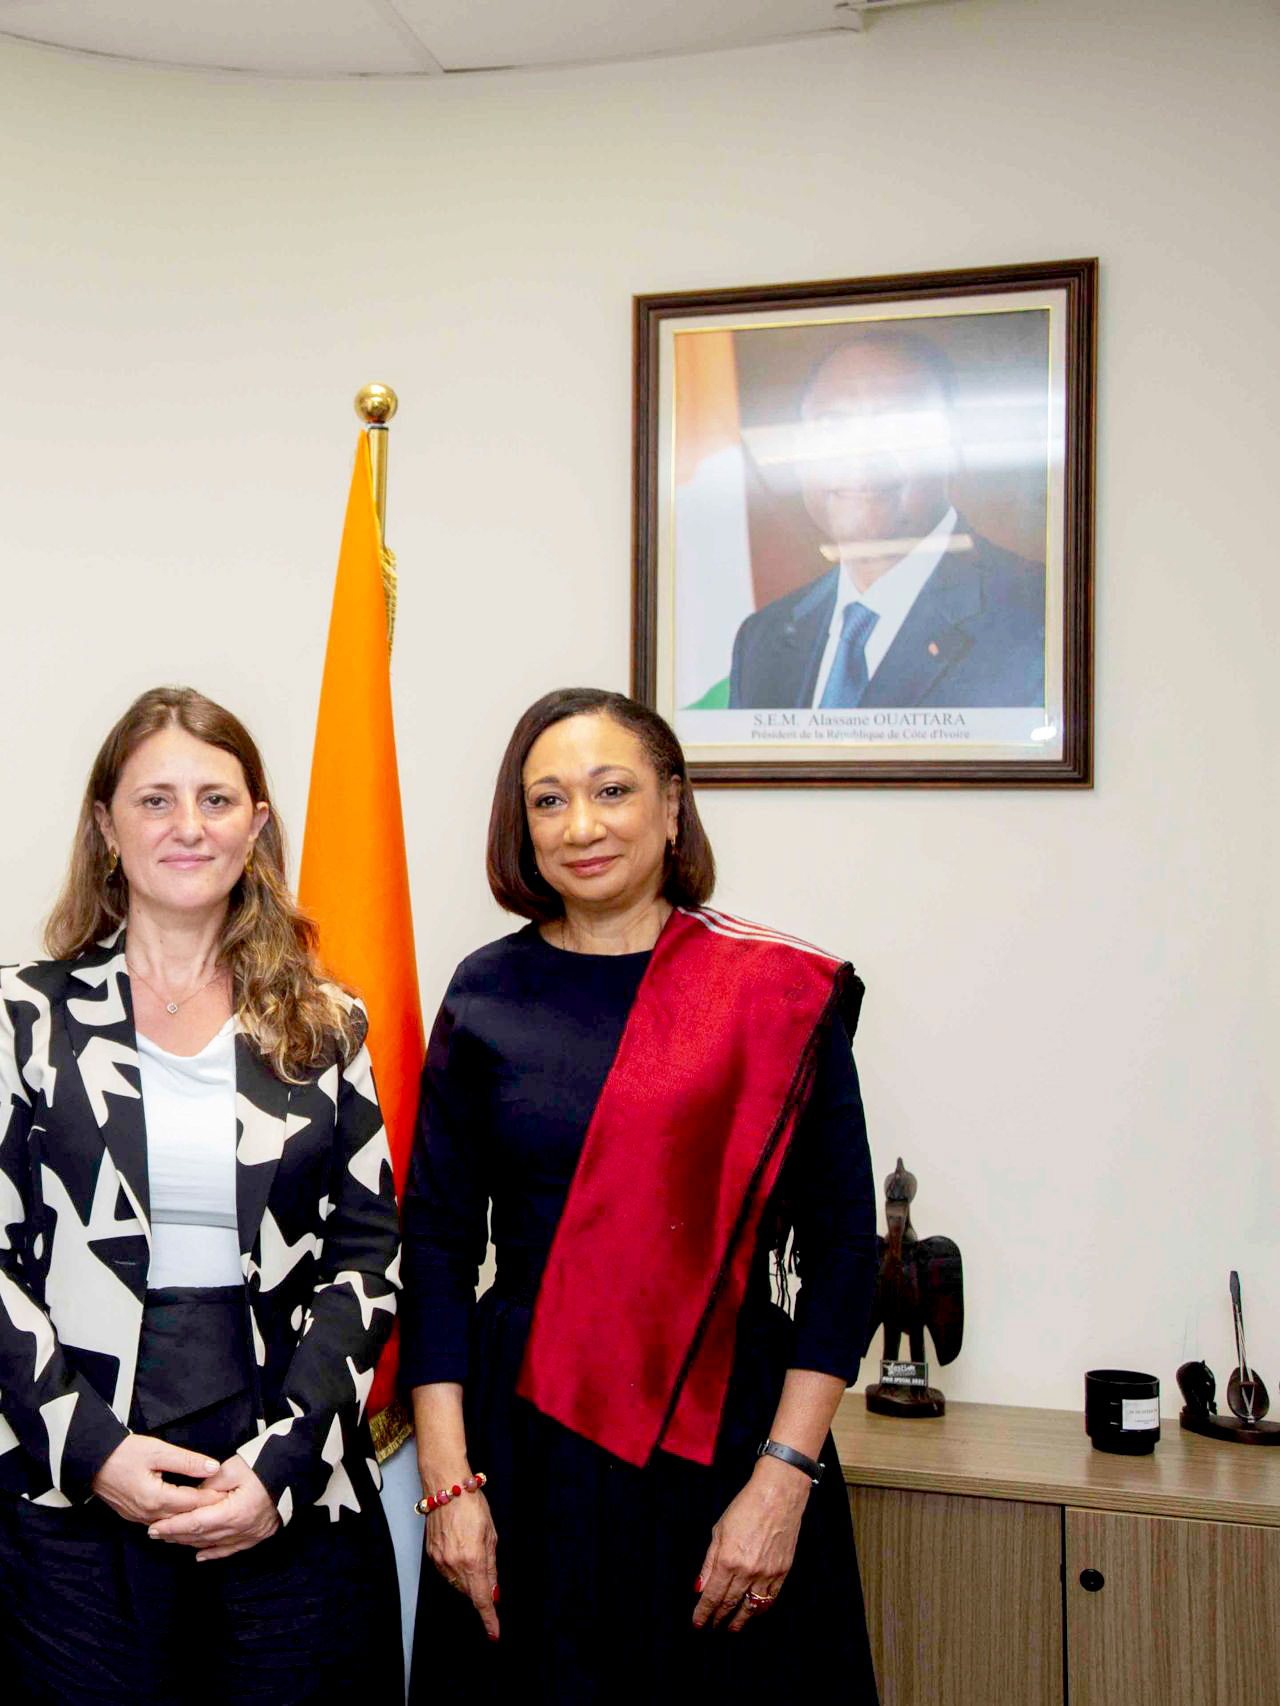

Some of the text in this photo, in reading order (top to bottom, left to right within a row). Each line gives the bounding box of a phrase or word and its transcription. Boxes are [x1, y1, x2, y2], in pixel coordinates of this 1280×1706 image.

[809, 713, 869, 726] Alassane
[874, 712, 966, 726] OUATTARA
[752, 729, 797, 739] Président
[800, 729, 810, 739] de
[815, 729, 824, 739] la
[826, 729, 884, 741] République
[888, 729, 898, 739] de
[903, 728, 927, 739] Côte
